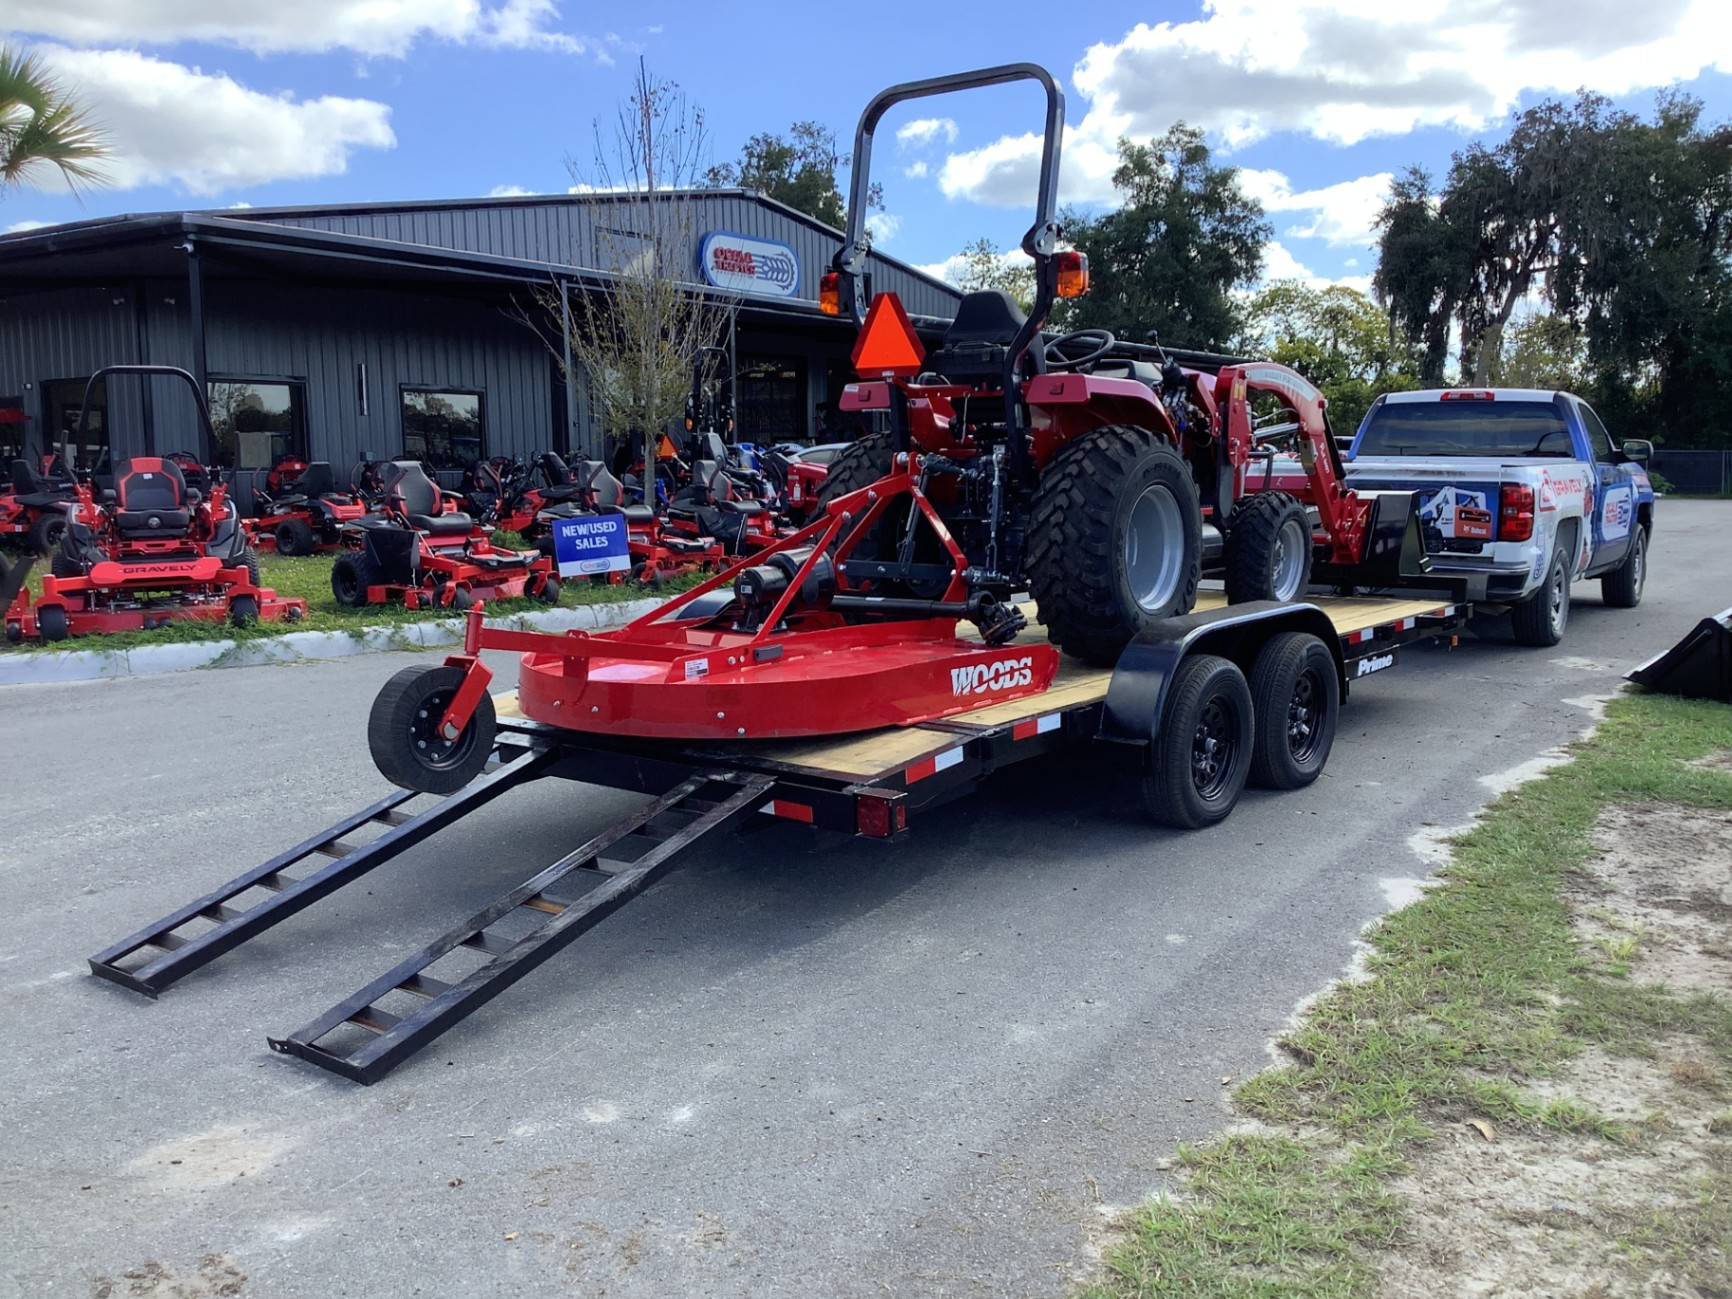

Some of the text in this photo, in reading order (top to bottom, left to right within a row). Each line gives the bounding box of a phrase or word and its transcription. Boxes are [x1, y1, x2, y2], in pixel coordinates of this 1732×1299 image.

[562, 521, 618, 538] NEW/USED
[575, 536, 609, 550] SALES
[123, 564, 196, 574] GRAVELY
[1357, 654, 1393, 677] Prime
[951, 657, 1033, 697] WOODS
